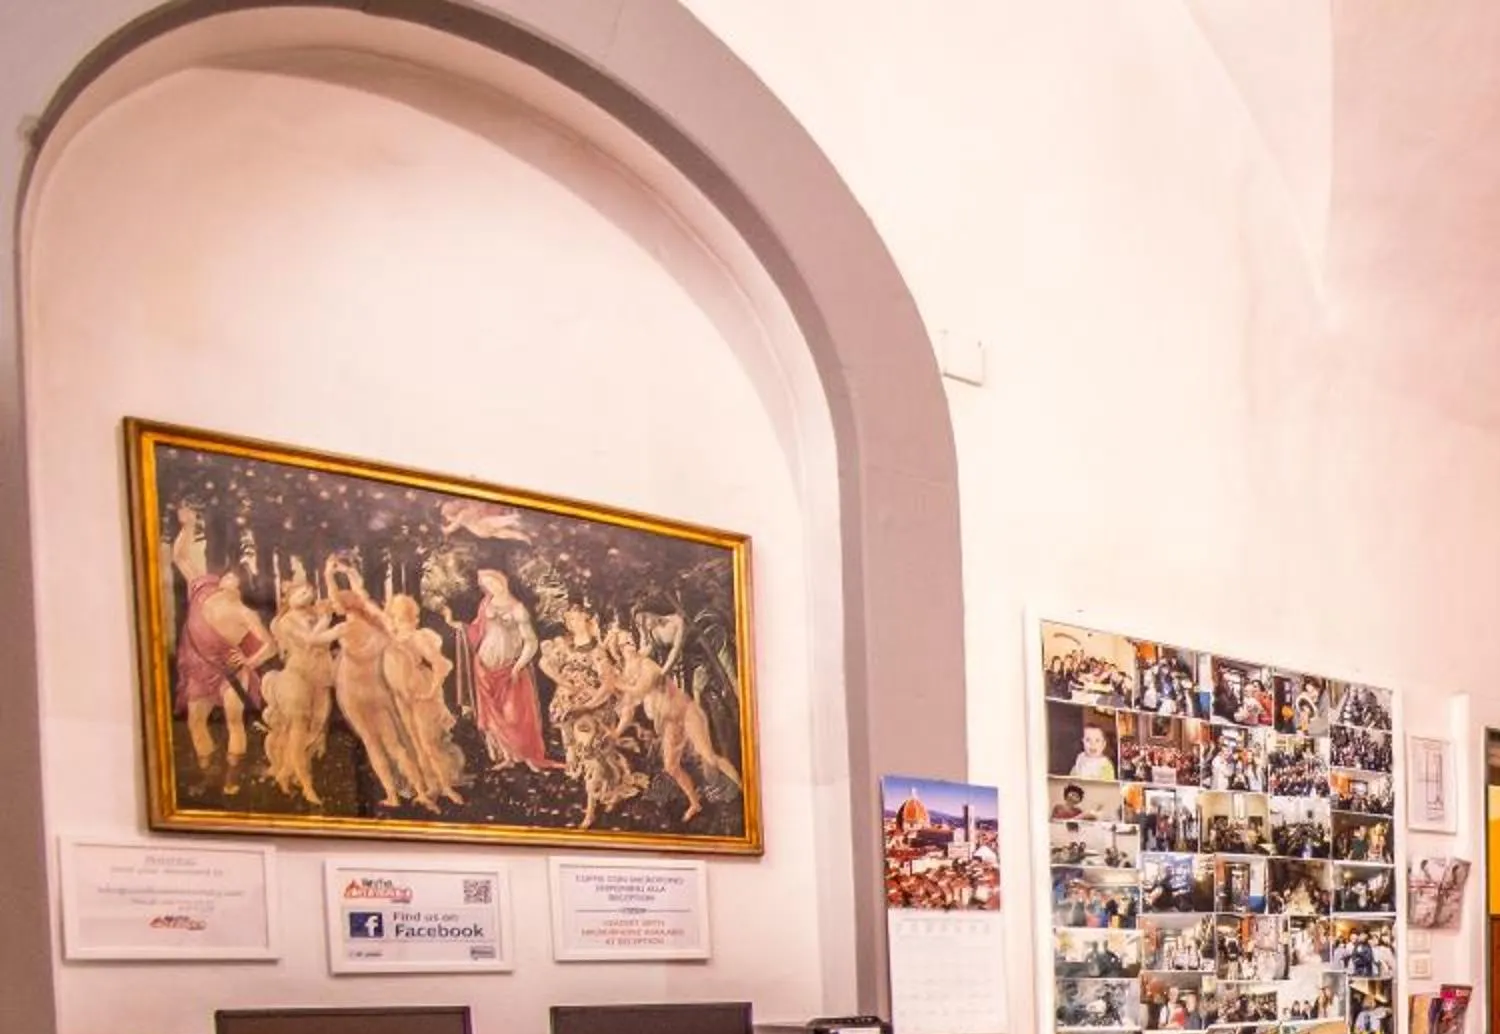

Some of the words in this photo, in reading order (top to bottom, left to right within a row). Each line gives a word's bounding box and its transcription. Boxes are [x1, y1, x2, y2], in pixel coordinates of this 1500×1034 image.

[393, 911, 421, 922] Find
[424, 913, 439, 921] us
[442, 913, 459, 921] on
[395, 923, 484, 938] Facebook
